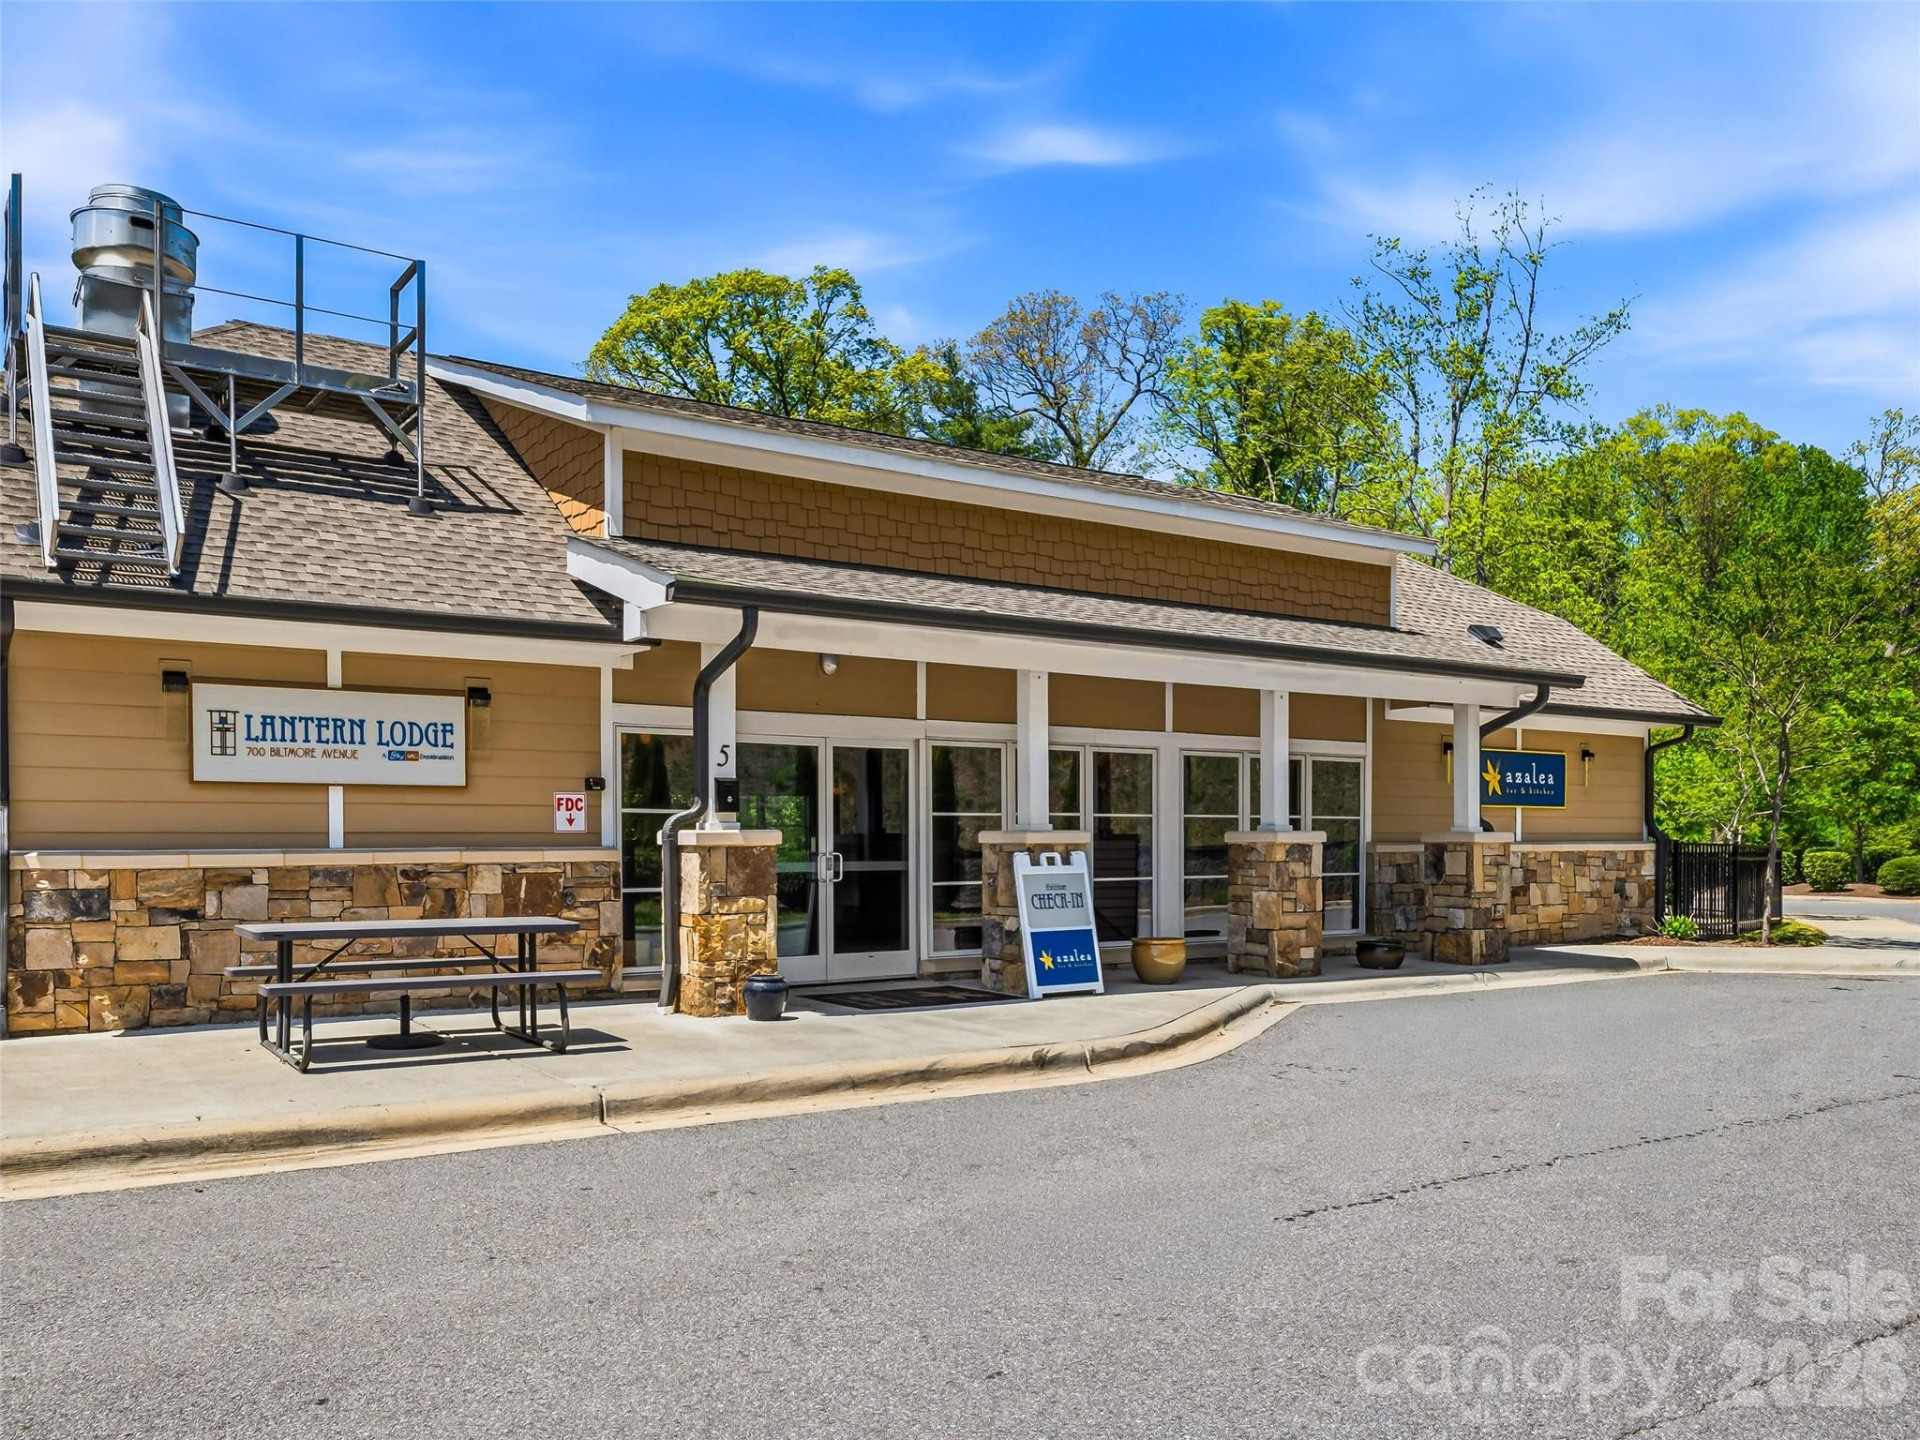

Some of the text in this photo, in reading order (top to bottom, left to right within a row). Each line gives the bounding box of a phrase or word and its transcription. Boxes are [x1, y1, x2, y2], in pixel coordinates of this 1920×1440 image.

[244, 714, 454, 749] LANTERN LODGE
[246, 747, 359, 759] 700 BILTMORE AVENUE
[717, 744, 730, 767] 5
[1505, 762, 1555, 784] azalea
[556, 797, 584, 812] FDC
[1031, 892, 1085, 910] CHECK-IN
[1056, 949, 1092, 962] azalea
